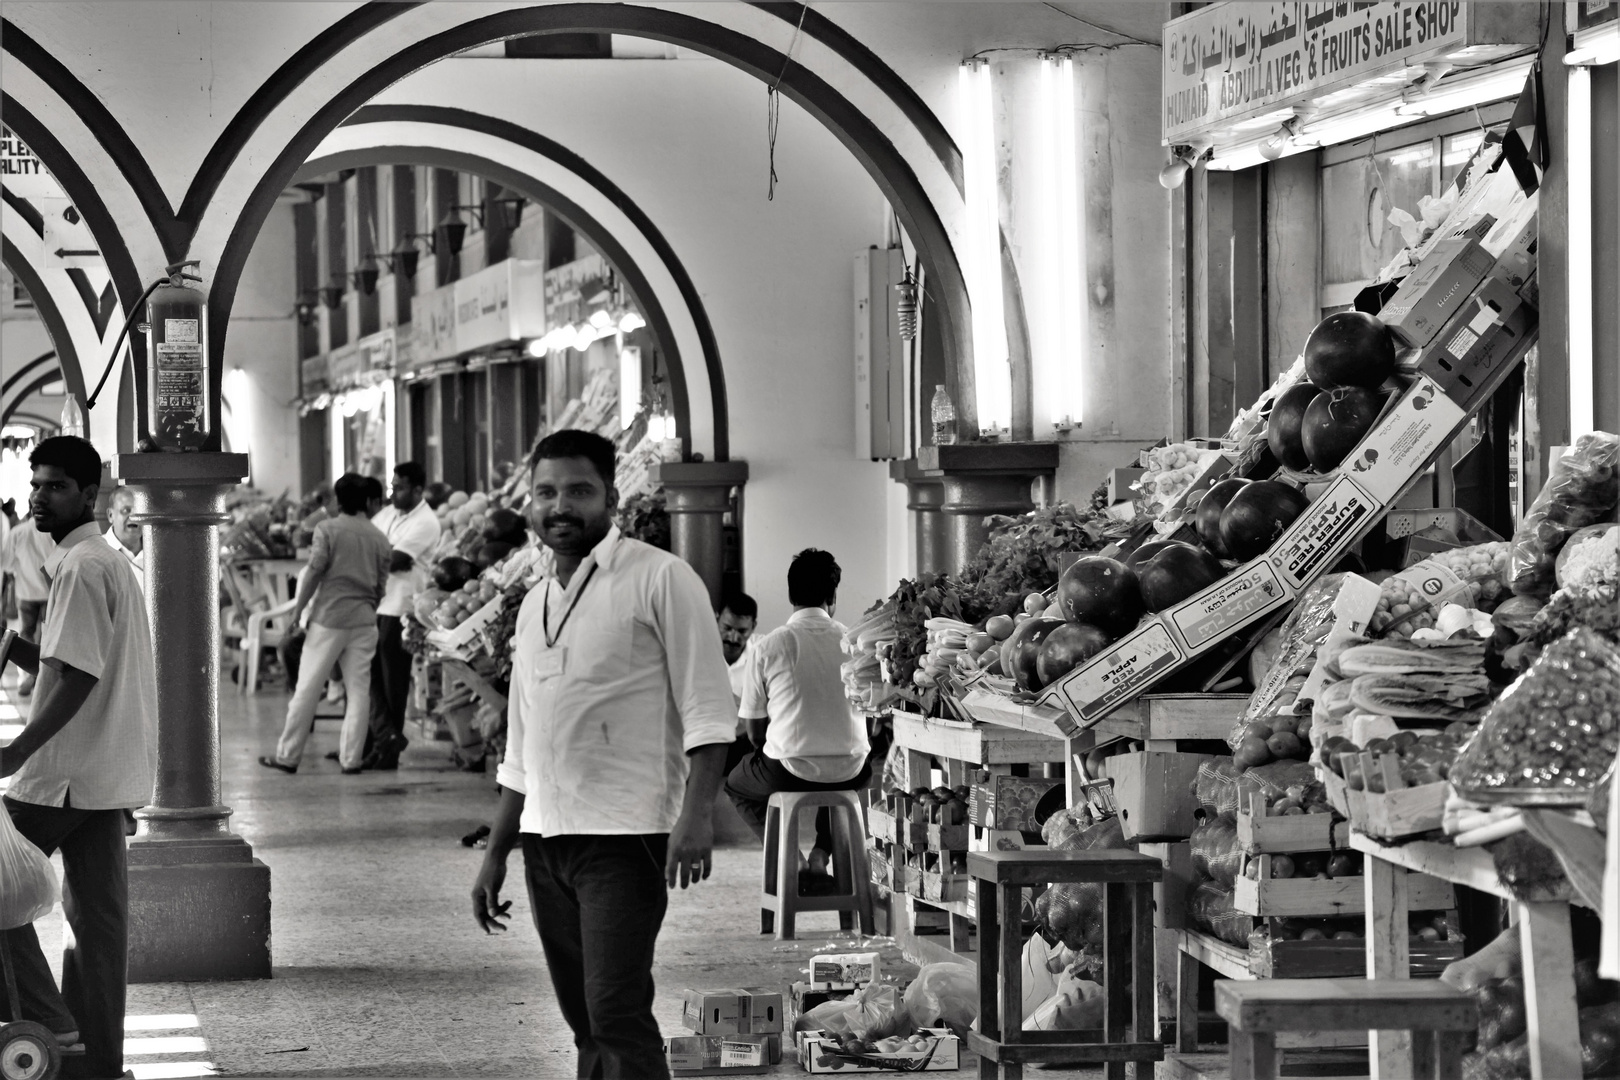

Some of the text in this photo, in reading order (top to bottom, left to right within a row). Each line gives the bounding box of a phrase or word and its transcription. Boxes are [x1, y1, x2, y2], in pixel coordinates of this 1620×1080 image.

[1166, 1, 1460, 128] HUMAID ABDULLA VEG. & FRUITS SALE SHOP
[1288, 501, 1338, 557] APPLE
[1288, 497, 1358, 571] SUPER RED
[1198, 611, 1225, 638] تفاح
[1100, 655, 1137, 683] APPLE
[1112, 667, 1135, 685] RED
[1103, 682, 1128, 703] تفاح
